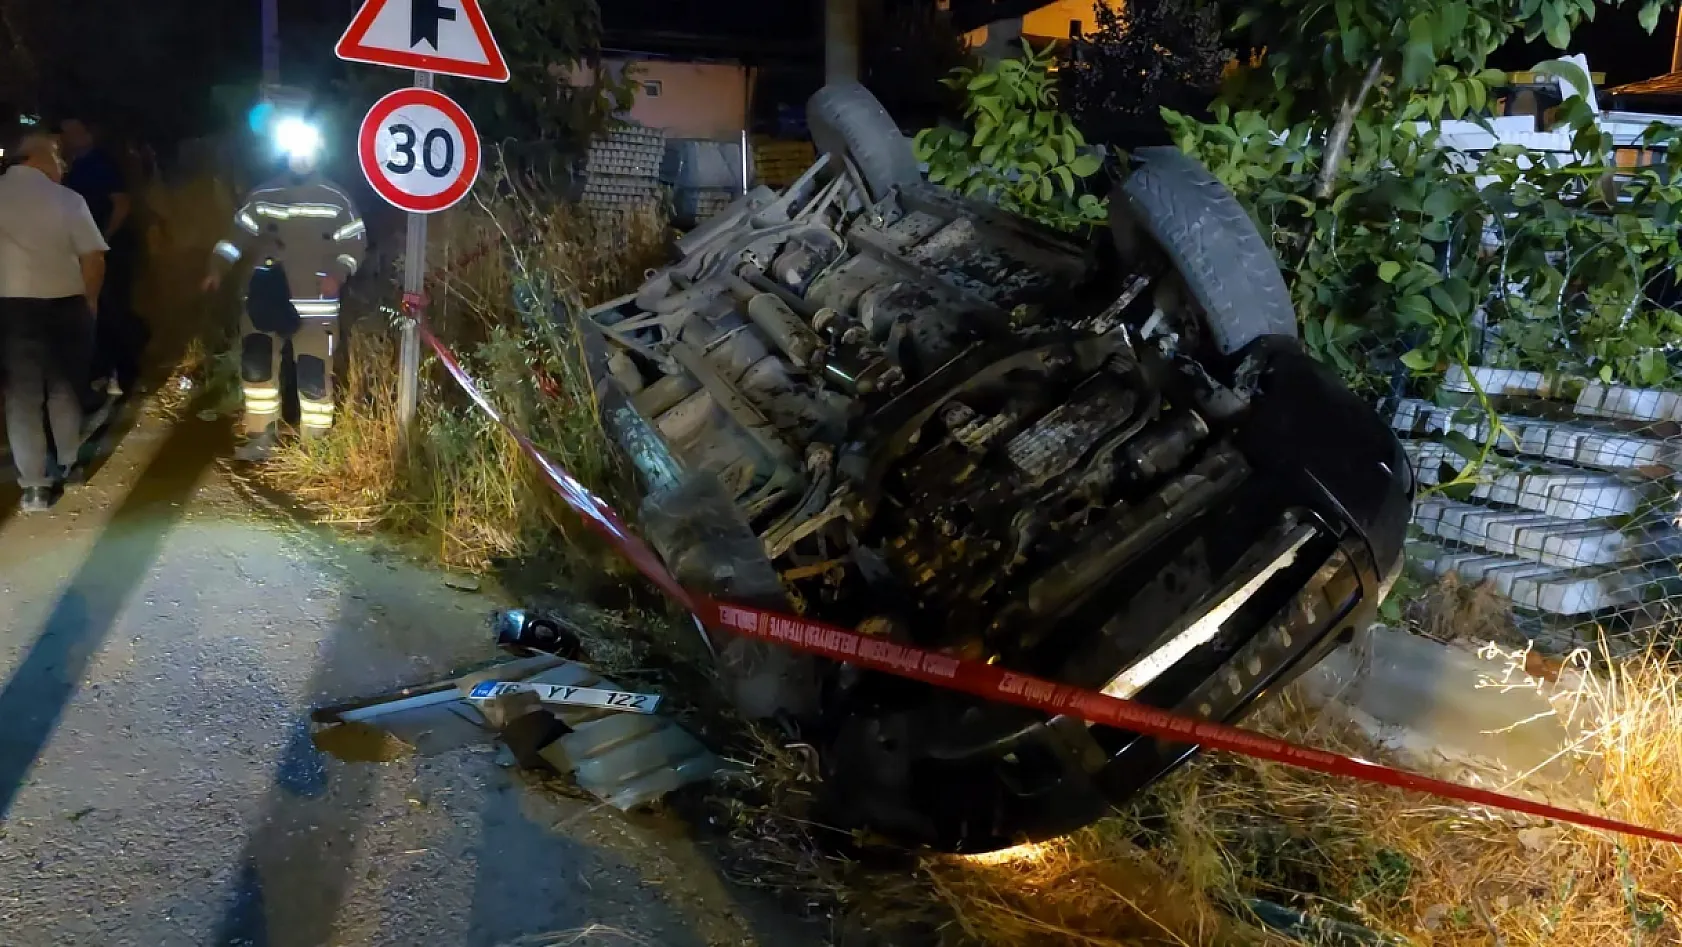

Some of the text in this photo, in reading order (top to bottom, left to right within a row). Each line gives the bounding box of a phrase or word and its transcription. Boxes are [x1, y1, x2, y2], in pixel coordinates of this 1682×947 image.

[386, 123, 454, 178] 30
[548, 685, 579, 700] YY
[605, 692, 648, 709] 122
